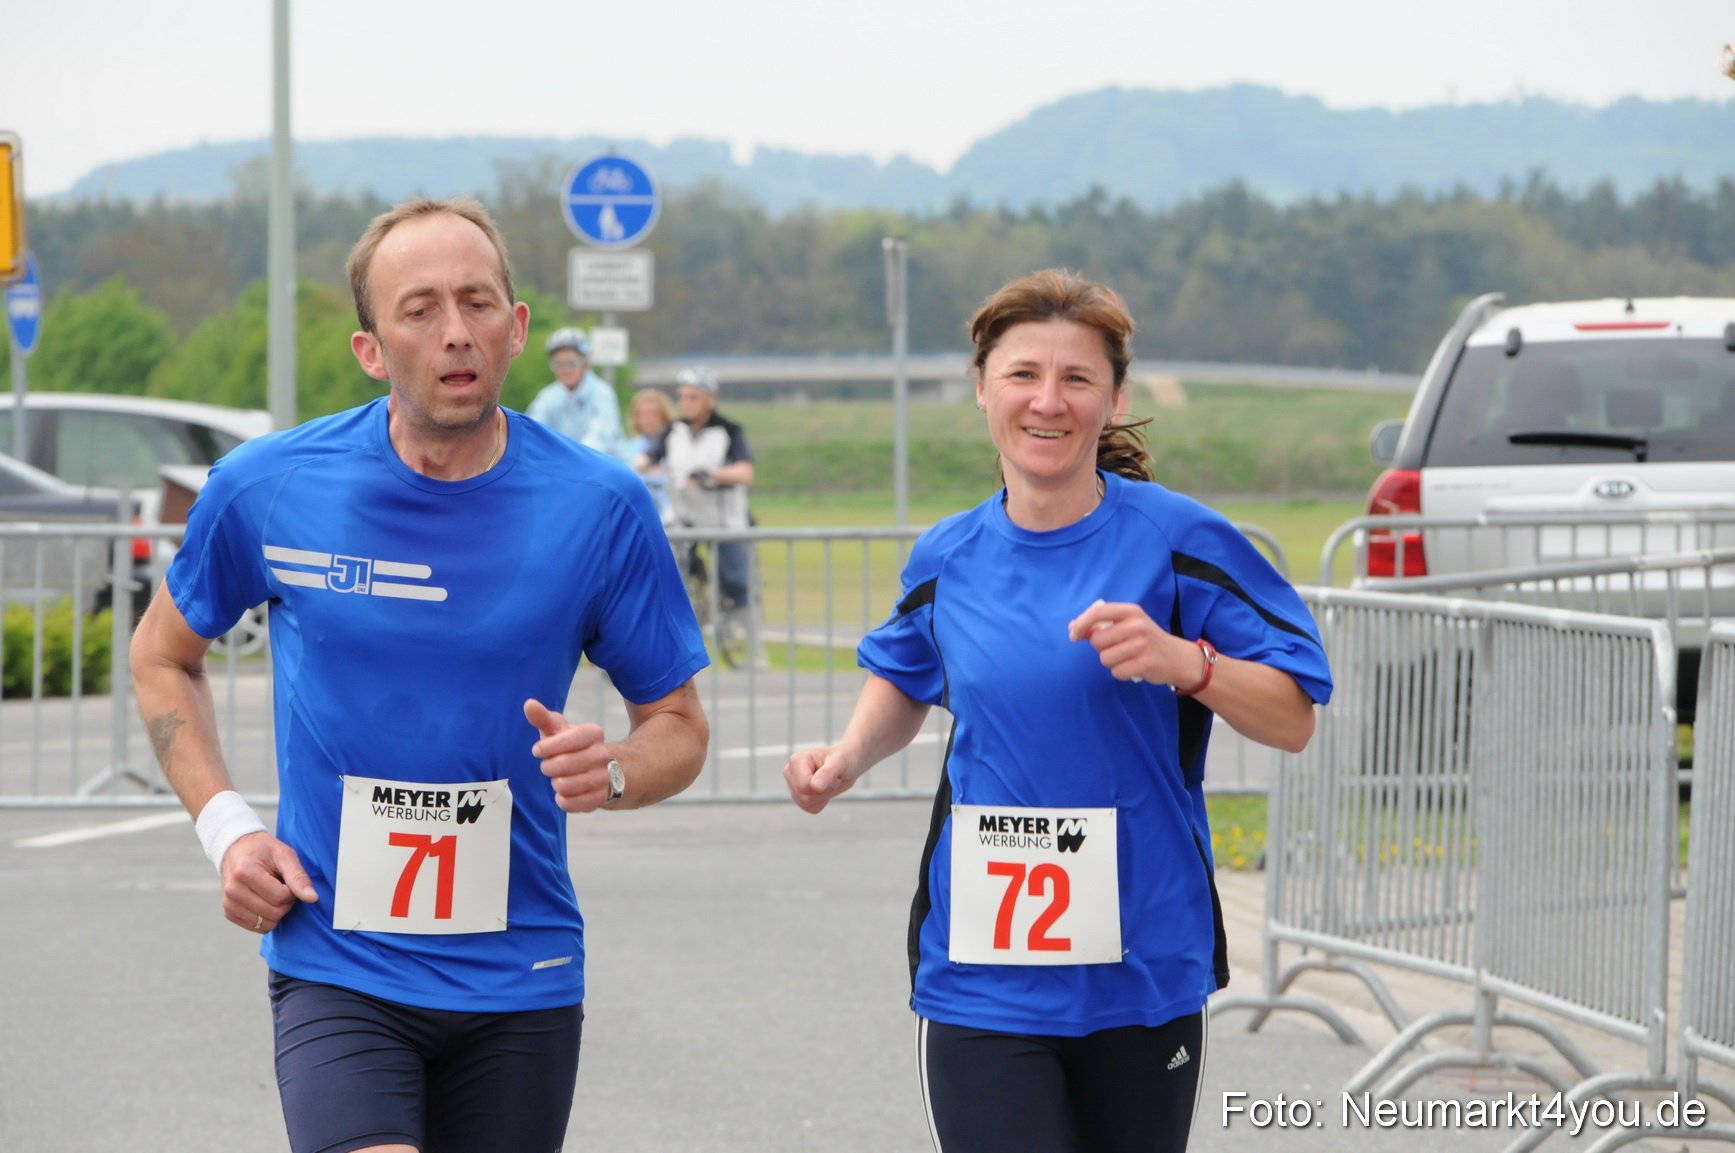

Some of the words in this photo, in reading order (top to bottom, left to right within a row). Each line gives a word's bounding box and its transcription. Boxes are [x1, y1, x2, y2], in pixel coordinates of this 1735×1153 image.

[372, 786, 451, 808] MEYER
[372, 804, 451, 821] WERBUNG
[979, 815, 1050, 835] MEYER
[979, 833, 1051, 849] WERBUNG
[388, 831, 457, 919] 71
[987, 861, 1071, 952] 72
